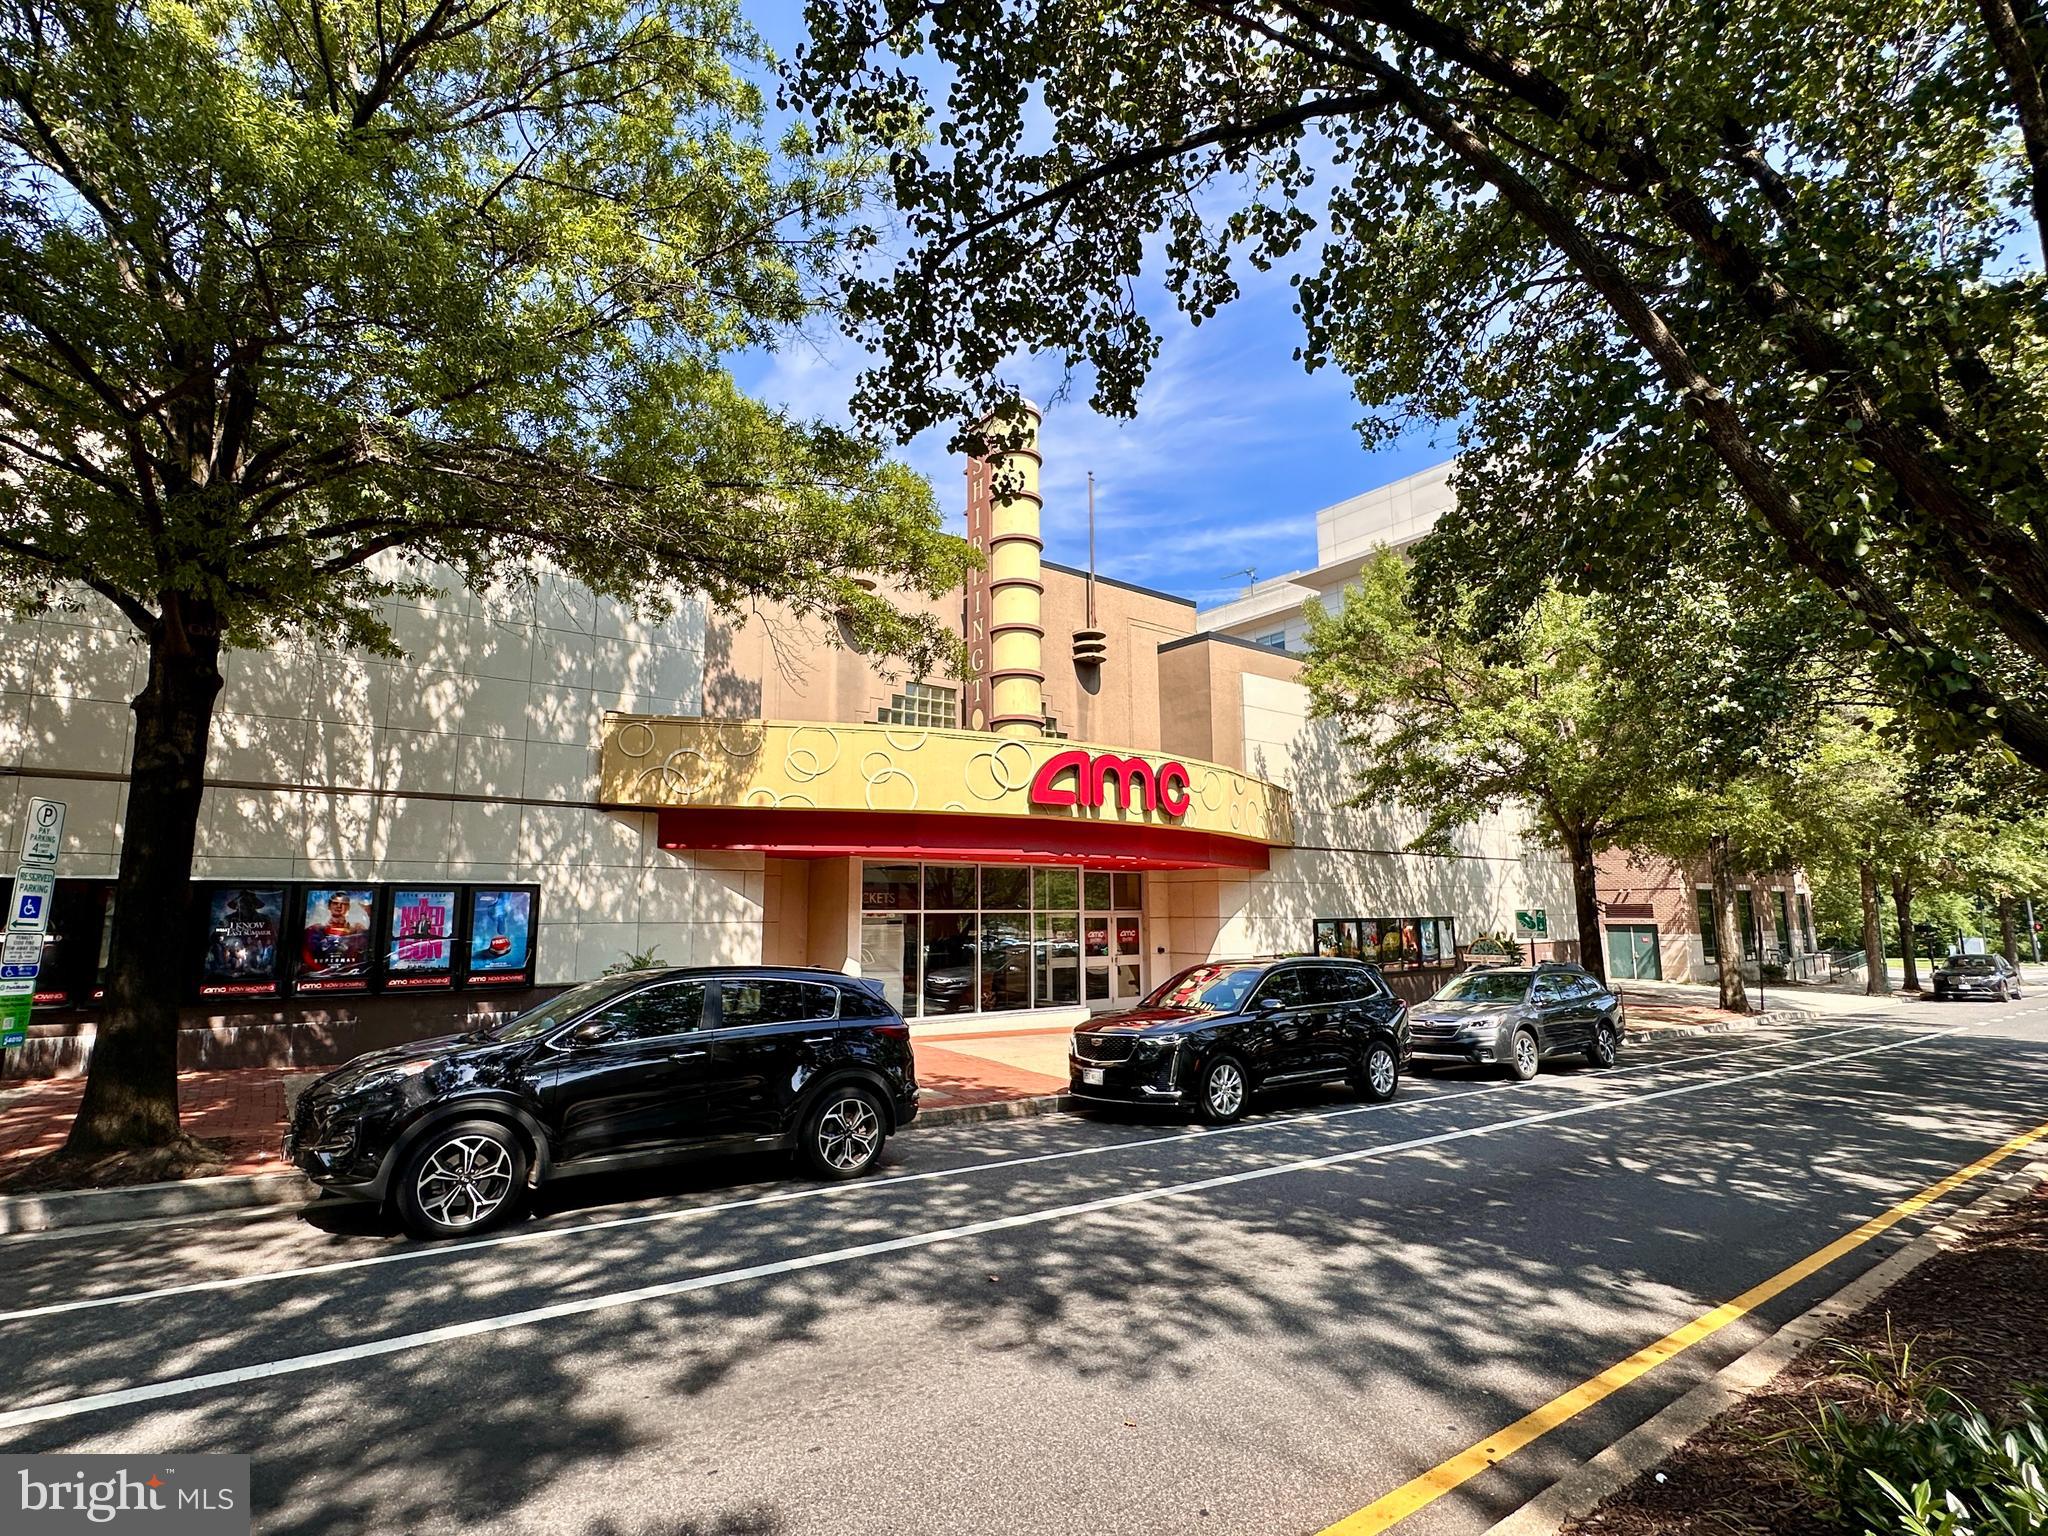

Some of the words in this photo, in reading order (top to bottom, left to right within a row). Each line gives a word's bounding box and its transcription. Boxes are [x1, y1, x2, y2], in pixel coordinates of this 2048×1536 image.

[42, 807, 53, 824] P
[39, 827, 51, 835] PAY
[29, 833, 56, 843] PARKING
[32, 843, 39, 853] 4
[20, 872, 53, 882] RESERVED
[19, 883, 49, 893] PARKING
[236, 922, 265, 930] KNOW
